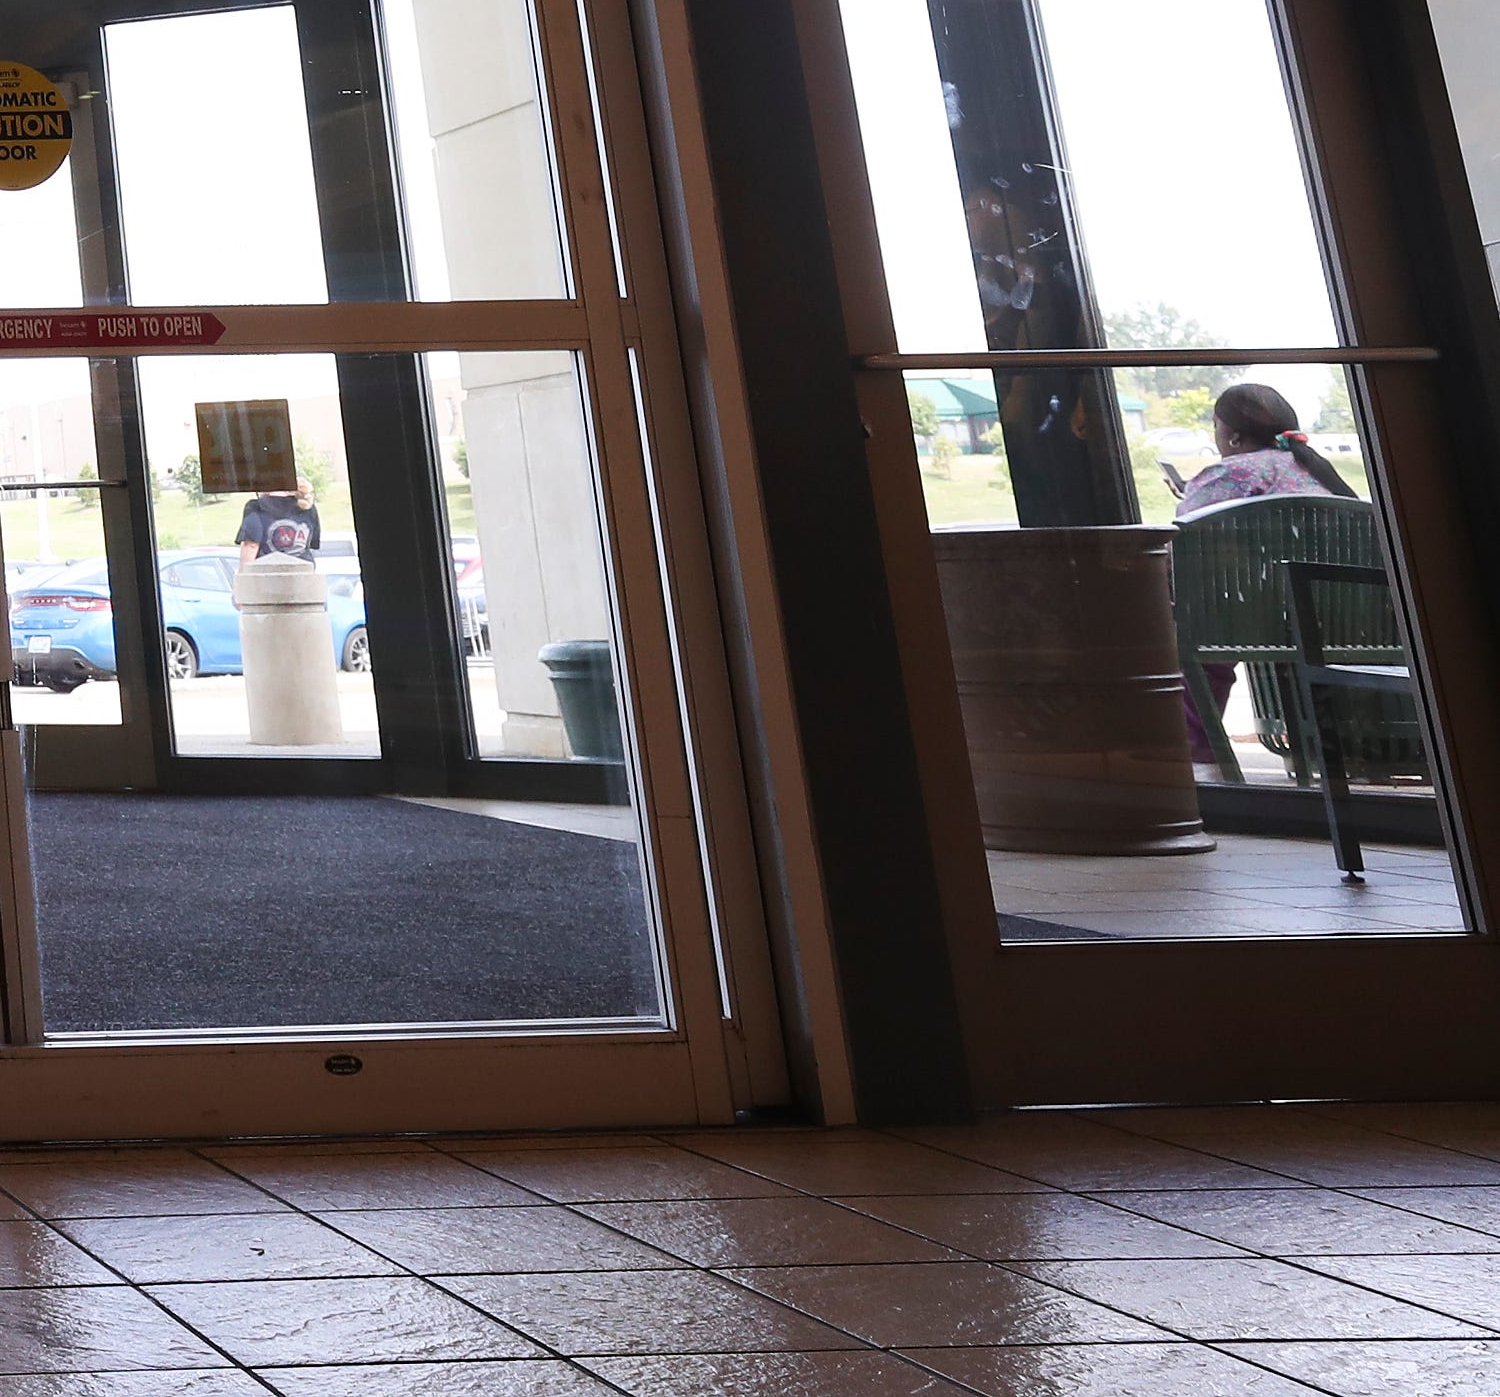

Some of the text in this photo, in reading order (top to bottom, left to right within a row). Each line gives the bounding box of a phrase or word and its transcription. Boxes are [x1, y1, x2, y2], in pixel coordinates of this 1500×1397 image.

[98, 317, 136, 338] PUSH
[140, 317, 160, 336] TO
[163, 316, 202, 336] OPEN
